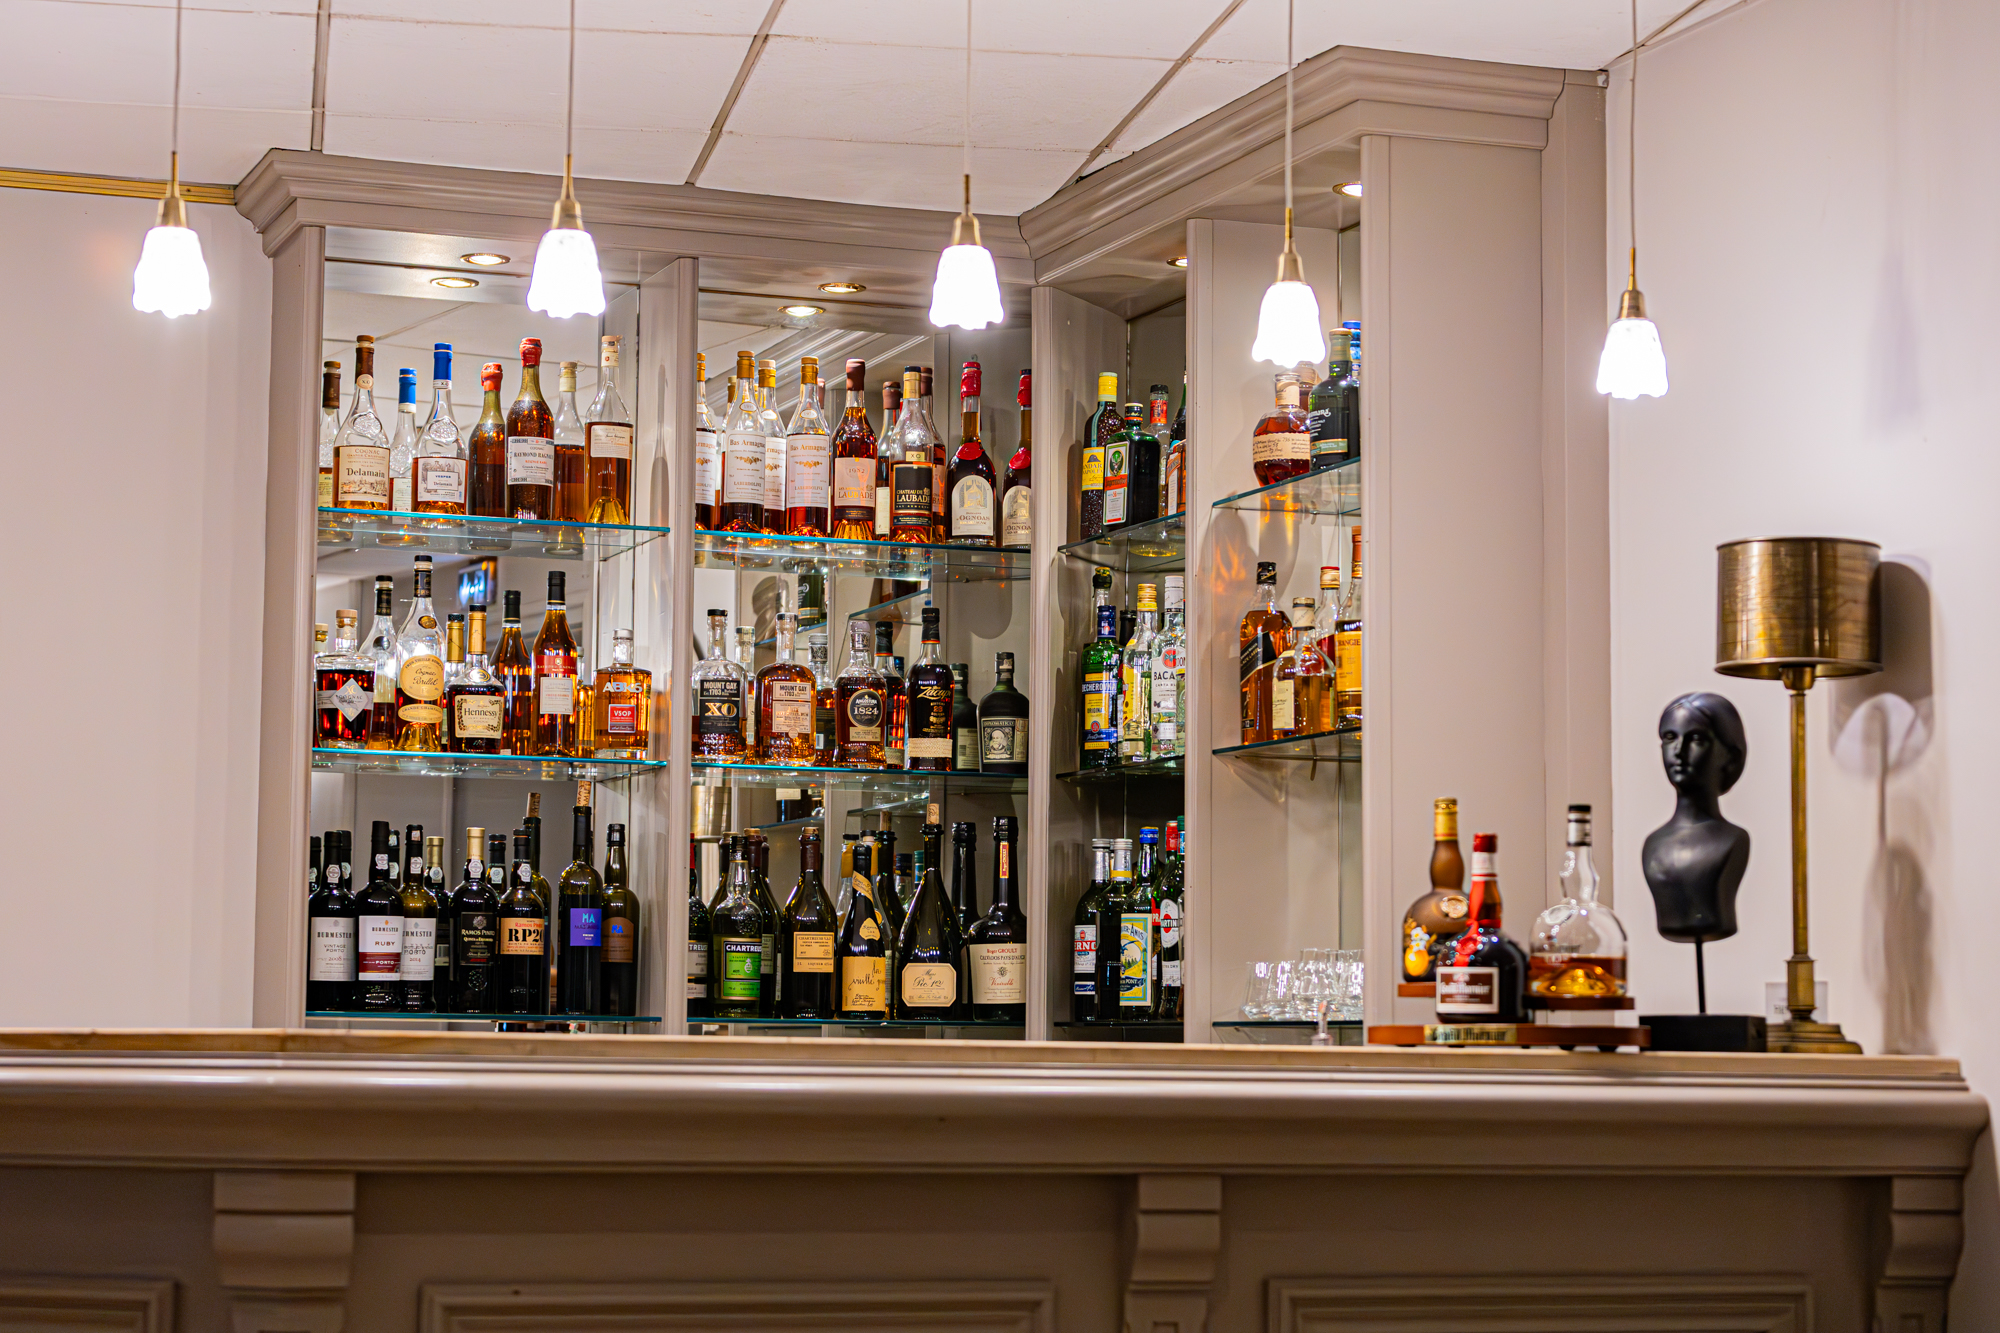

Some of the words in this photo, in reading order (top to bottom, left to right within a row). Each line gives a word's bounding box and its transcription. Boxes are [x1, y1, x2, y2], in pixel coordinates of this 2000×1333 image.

[346, 468, 386, 478] Delamain
[838, 491, 873, 499] LAUBADE
[1154, 671, 1175, 680] BACA
[602, 682, 642, 693] ABK6
[464, 708, 497, 718] Hennessy
[705, 703, 737, 717] XO
[582, 913, 595, 923] MA
[611, 925, 624, 933] MA
